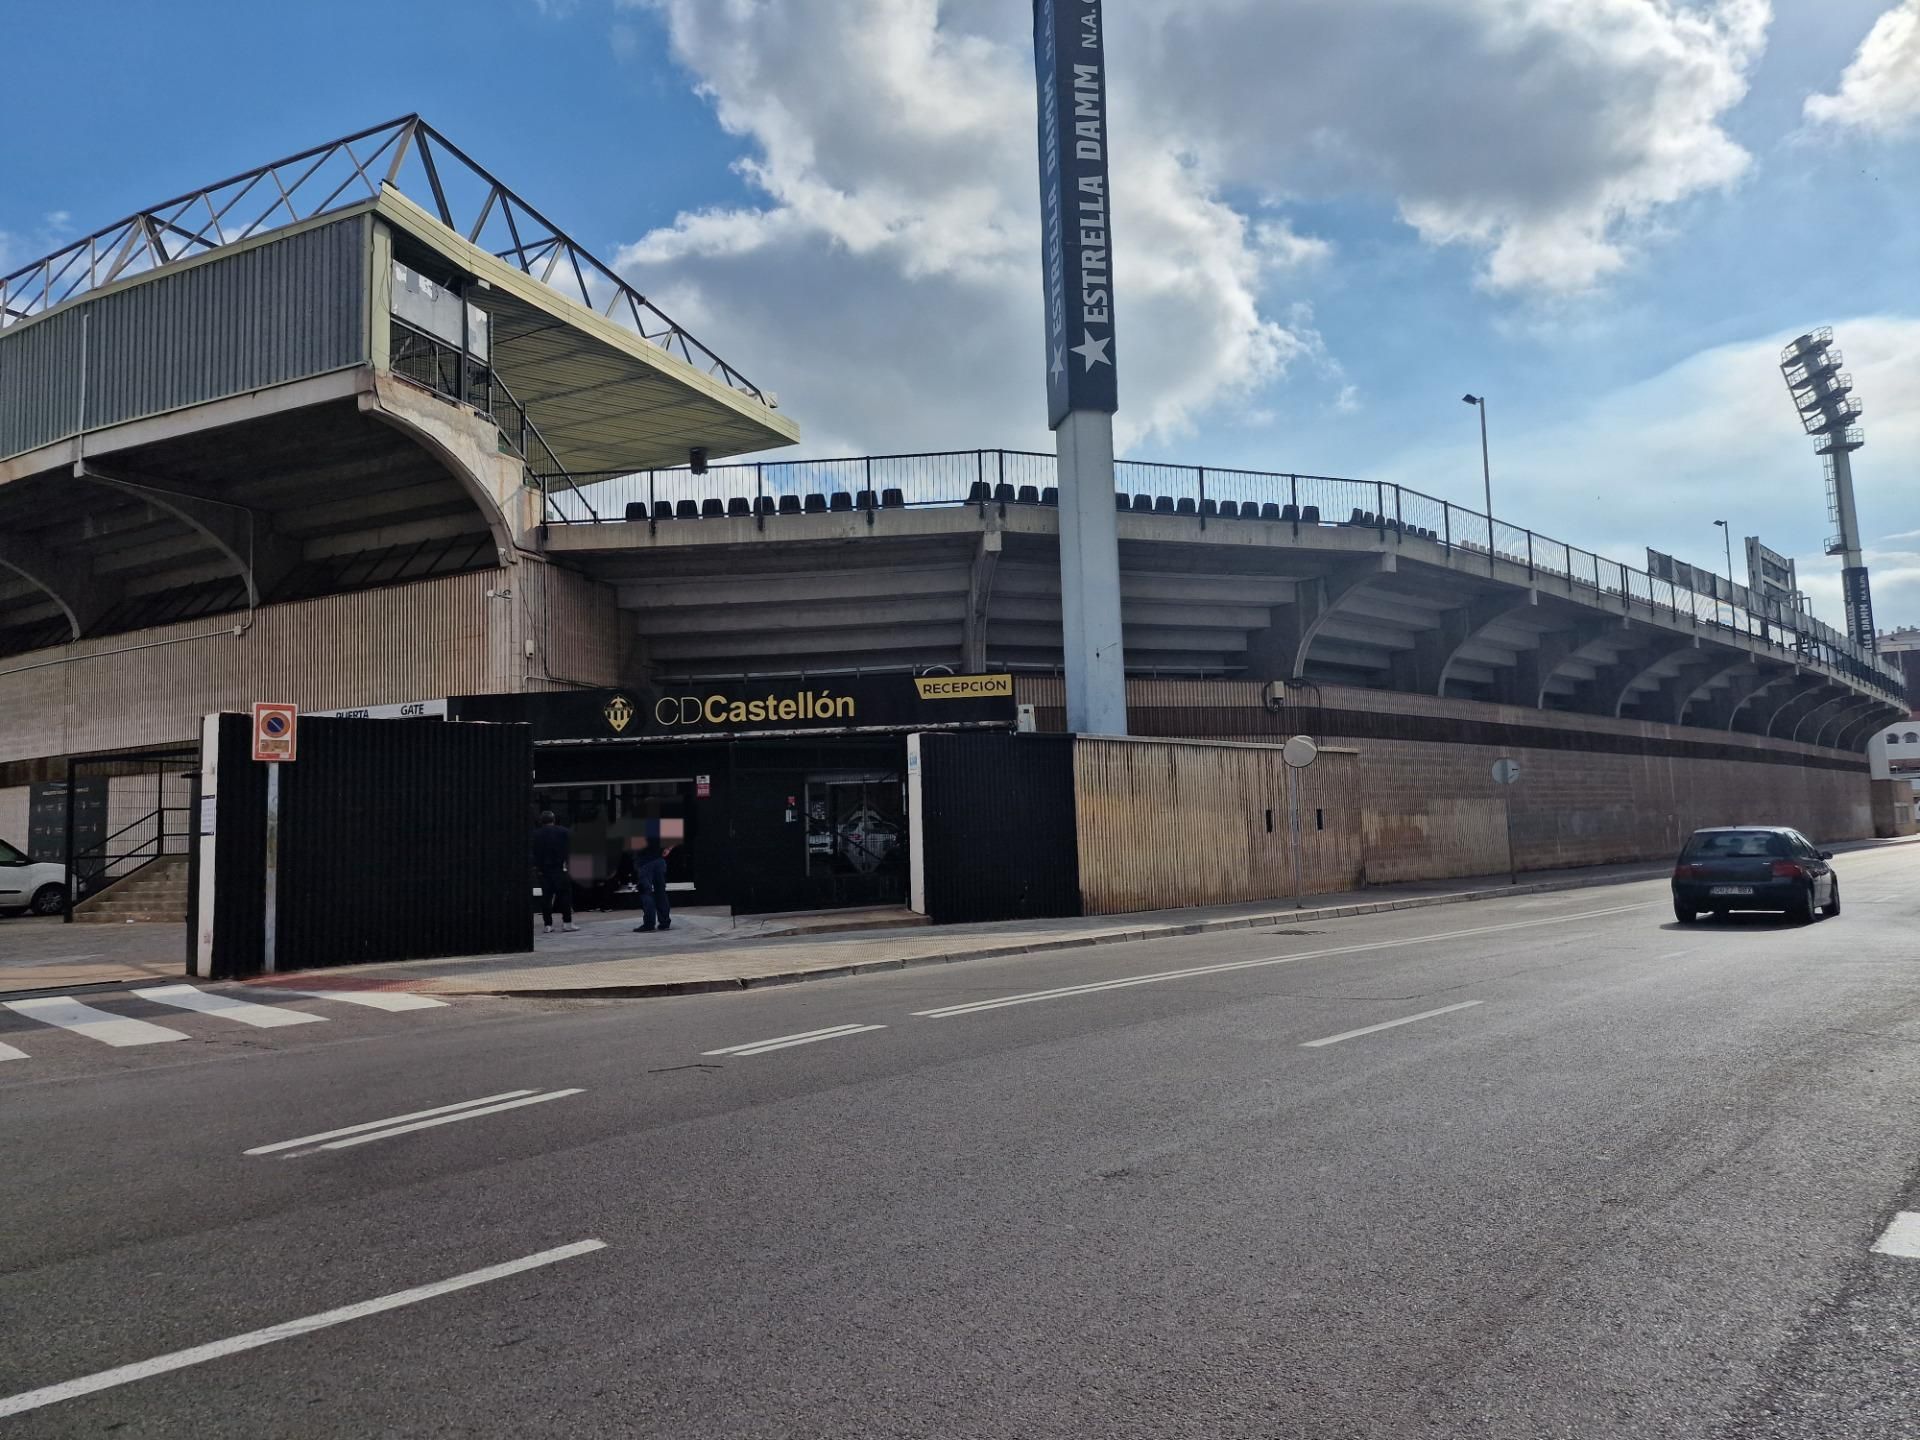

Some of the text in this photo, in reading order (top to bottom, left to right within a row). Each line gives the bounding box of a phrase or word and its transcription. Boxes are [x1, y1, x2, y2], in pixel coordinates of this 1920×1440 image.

[1044, 72, 1056, 176] DAMM
[1073, 64, 1101, 160] DAMM
[1048, 183, 1062, 337] ESTRELLA
[1078, 176, 1108, 323] ESTRELLA
[400, 704, 424, 715] GATE
[923, 678, 1006, 694] RECEPCIÓN
